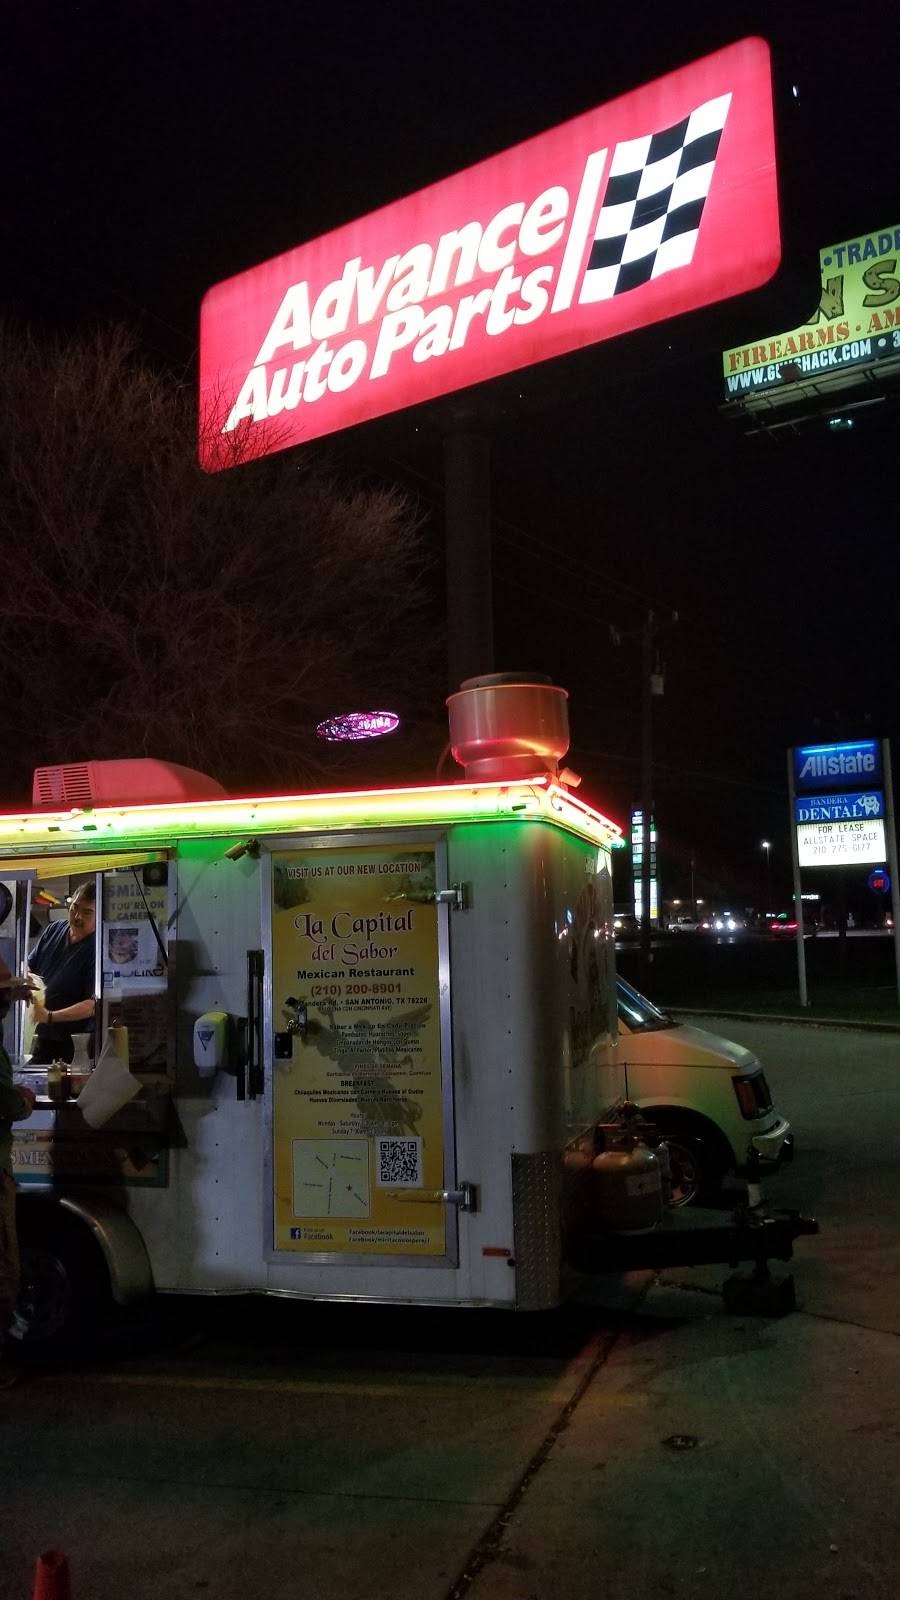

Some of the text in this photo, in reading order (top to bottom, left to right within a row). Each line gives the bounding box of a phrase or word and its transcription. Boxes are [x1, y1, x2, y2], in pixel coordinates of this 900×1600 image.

[255, 185, 569, 365] Advance
[221, 264, 554, 434] Auto Parts
[729, 320, 850, 372] FIREARMS
[799, 752, 875, 778] Allstate
[810, 797, 848, 807] BANDERA
[798, 804, 863, 822] DENTAL
[818, 823, 864, 834] FOR LEASE
[804, 832, 878, 845] ALLSTATE SPACE
[813, 846, 827, 854] 210
[288, 862, 422, 879] VISIT US AT OUR NEW LOCATION
[150, 900, 165, 909] ON
[294, 909, 414, 943] La Capital
[312, 942, 398, 965] del Sabor
[297, 967, 415, 980] Mexican Restaurant
[311, 983, 401, 997] (210) 200-8901
[304, 1232, 334, 1240] Facebook
